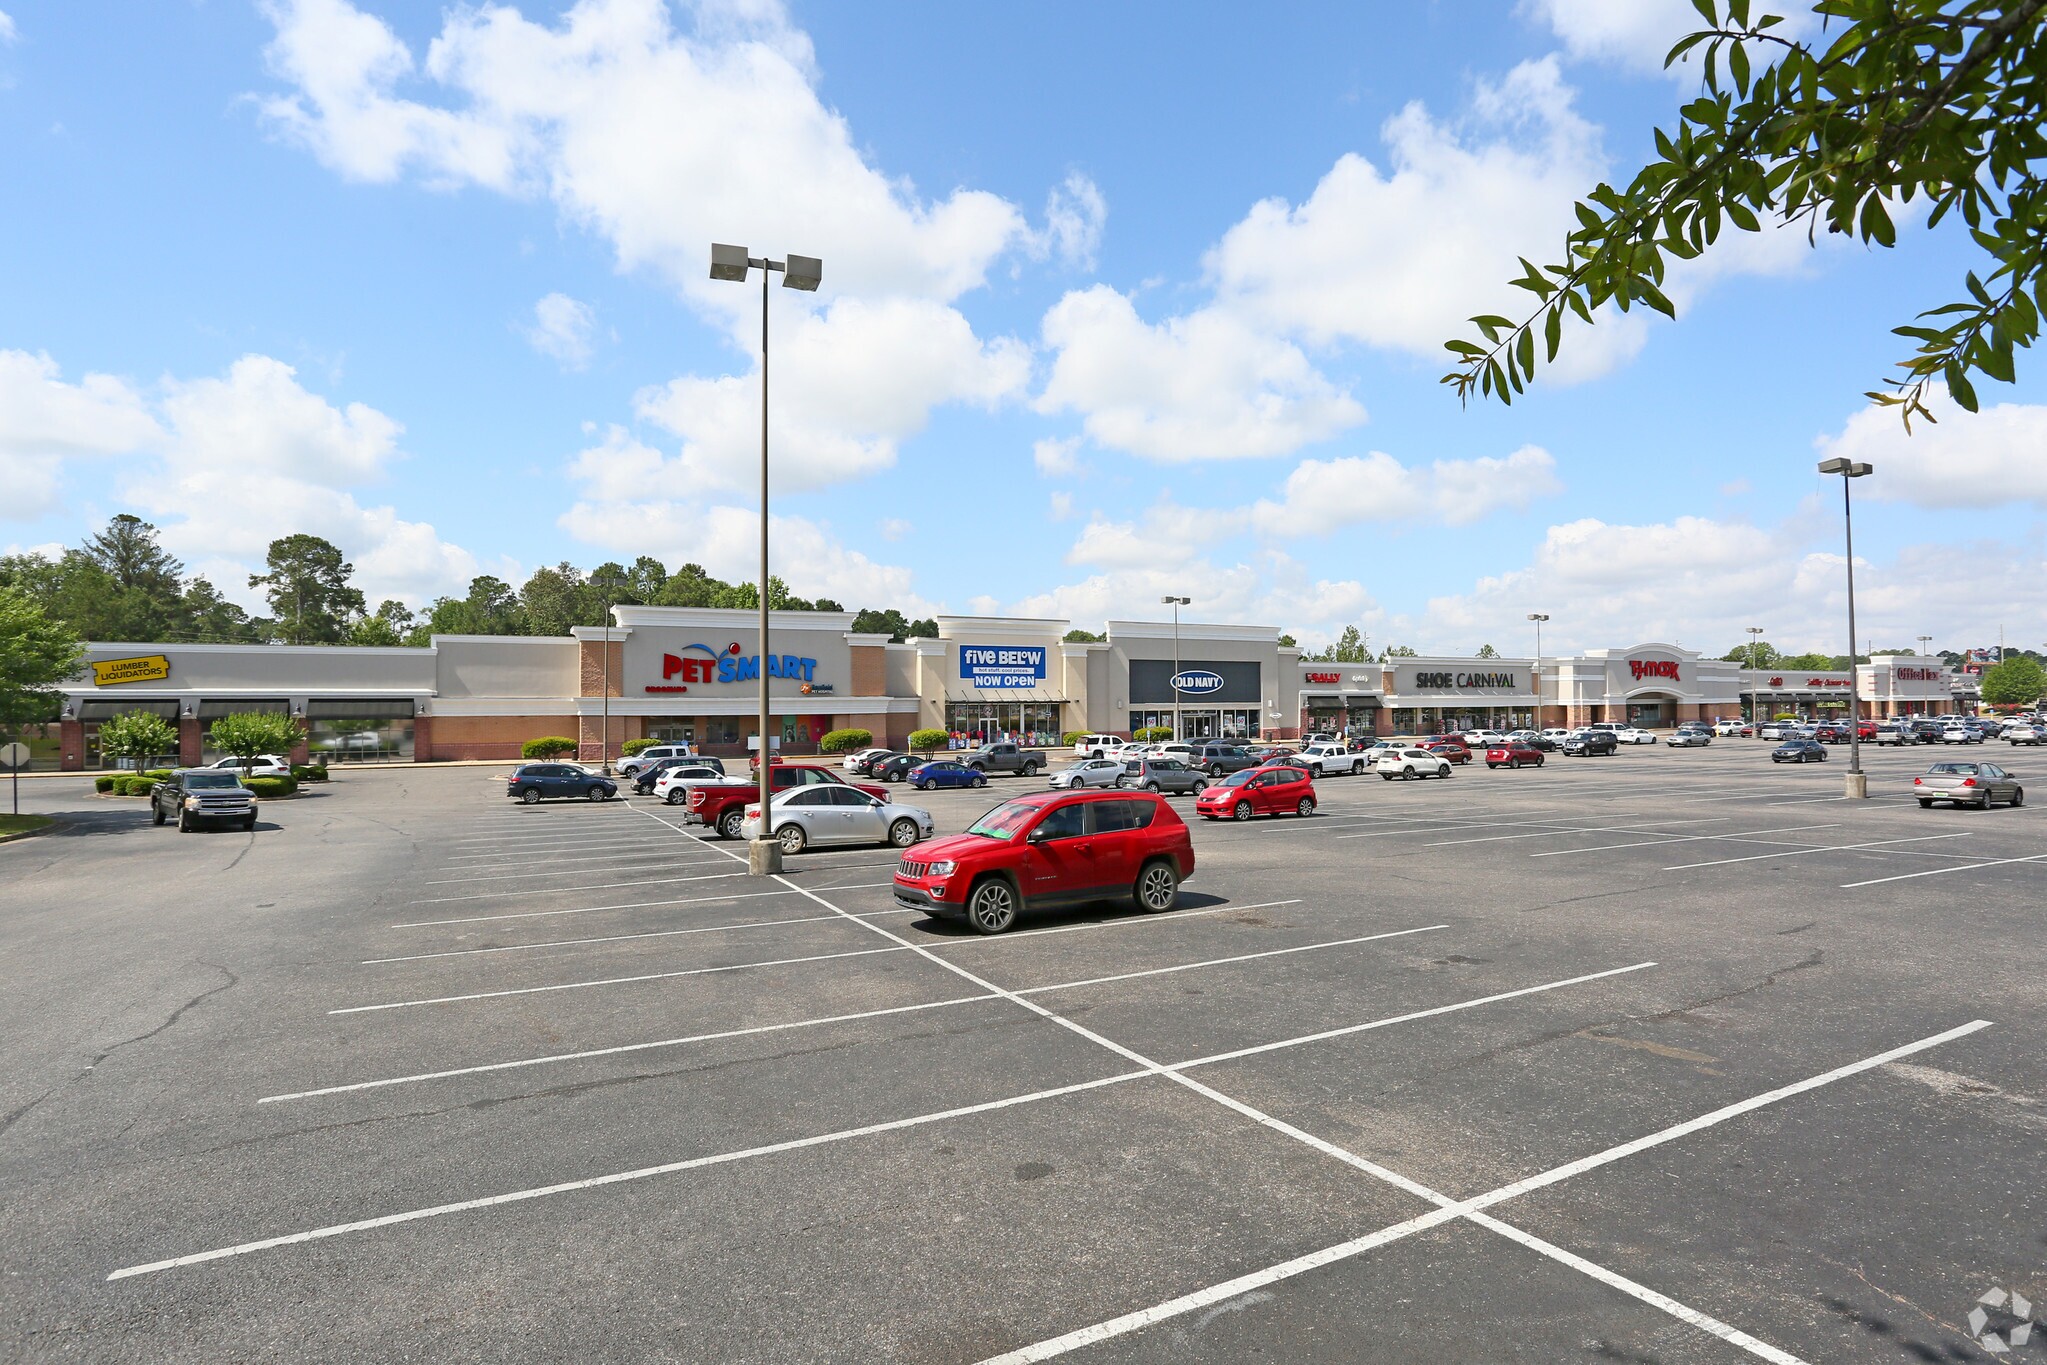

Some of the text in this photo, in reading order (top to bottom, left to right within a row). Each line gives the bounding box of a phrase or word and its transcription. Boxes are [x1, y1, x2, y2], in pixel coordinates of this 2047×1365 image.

[964, 649, 1041, 665] five BELOW
[111, 662, 149, 671] LUMBER
[101, 667, 162, 680] LIQUIDATORS
[975, 676, 1001, 686] NOW
[1177, 676, 1219, 688] OLD NAVY
[1416, 672, 1453, 689] SHOE
